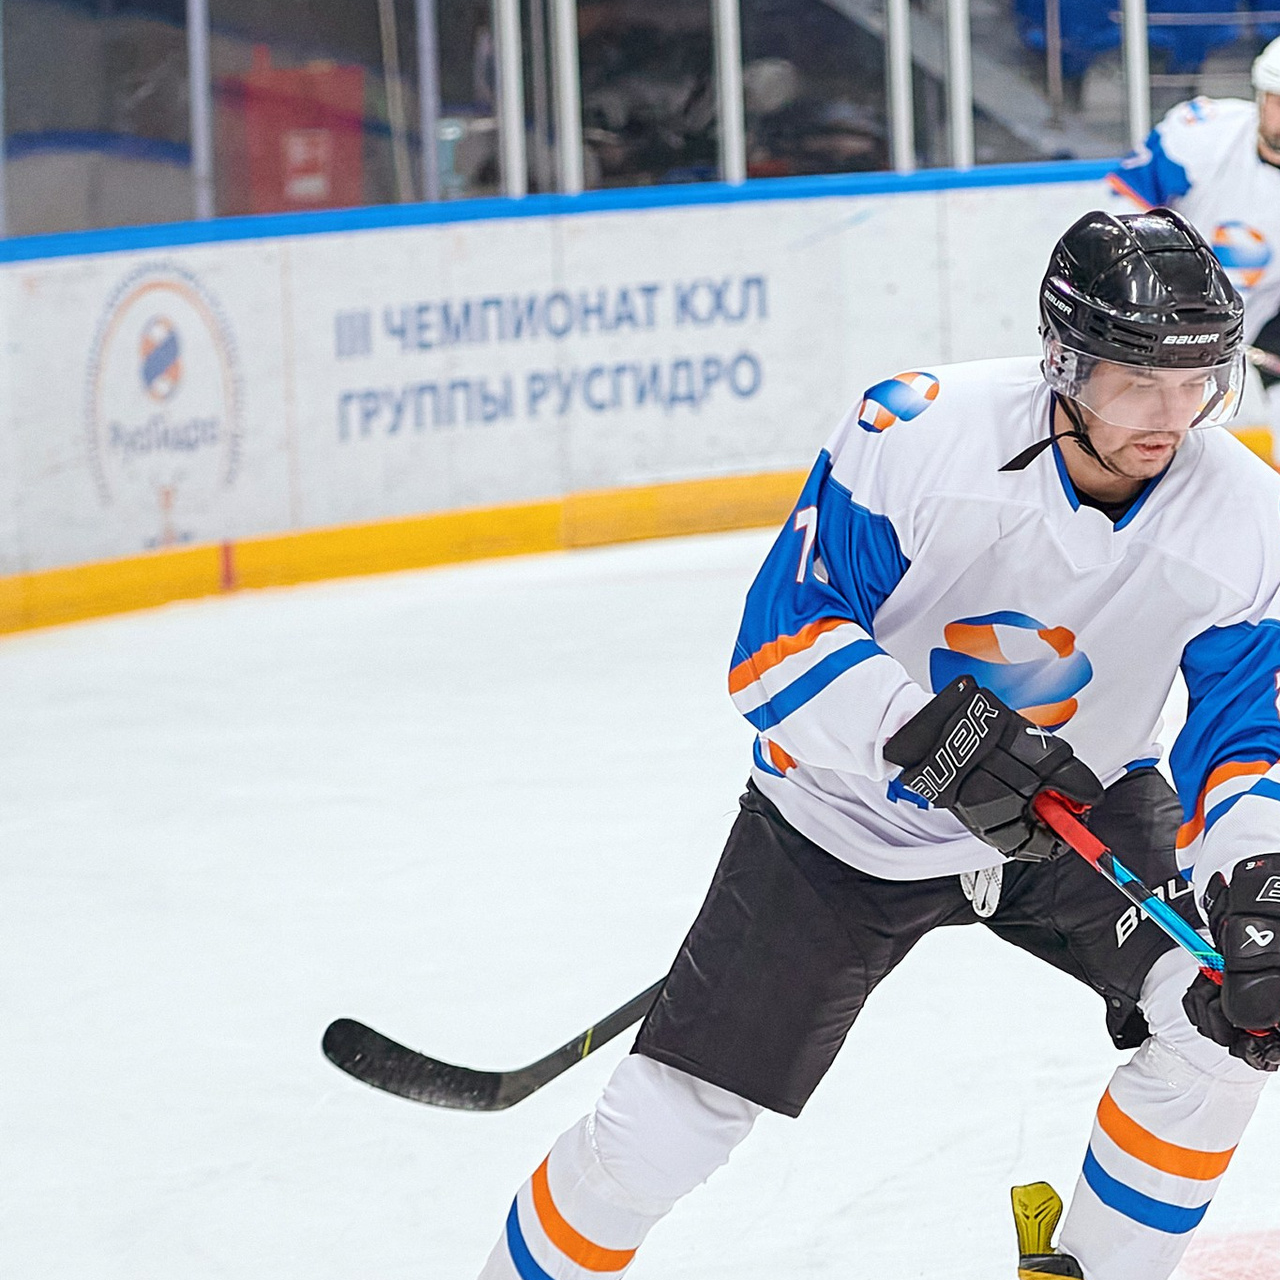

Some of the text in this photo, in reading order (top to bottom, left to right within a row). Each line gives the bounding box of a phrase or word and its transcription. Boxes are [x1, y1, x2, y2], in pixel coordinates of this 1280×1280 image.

[384, 285, 659, 352] ЧЕМПИОНАТ
[675, 274, 769, 327] КХЛ
[1162, 332, 1220, 346] BAUER
[338, 349, 762, 444] ГРУППЫ РУСГИДРО
